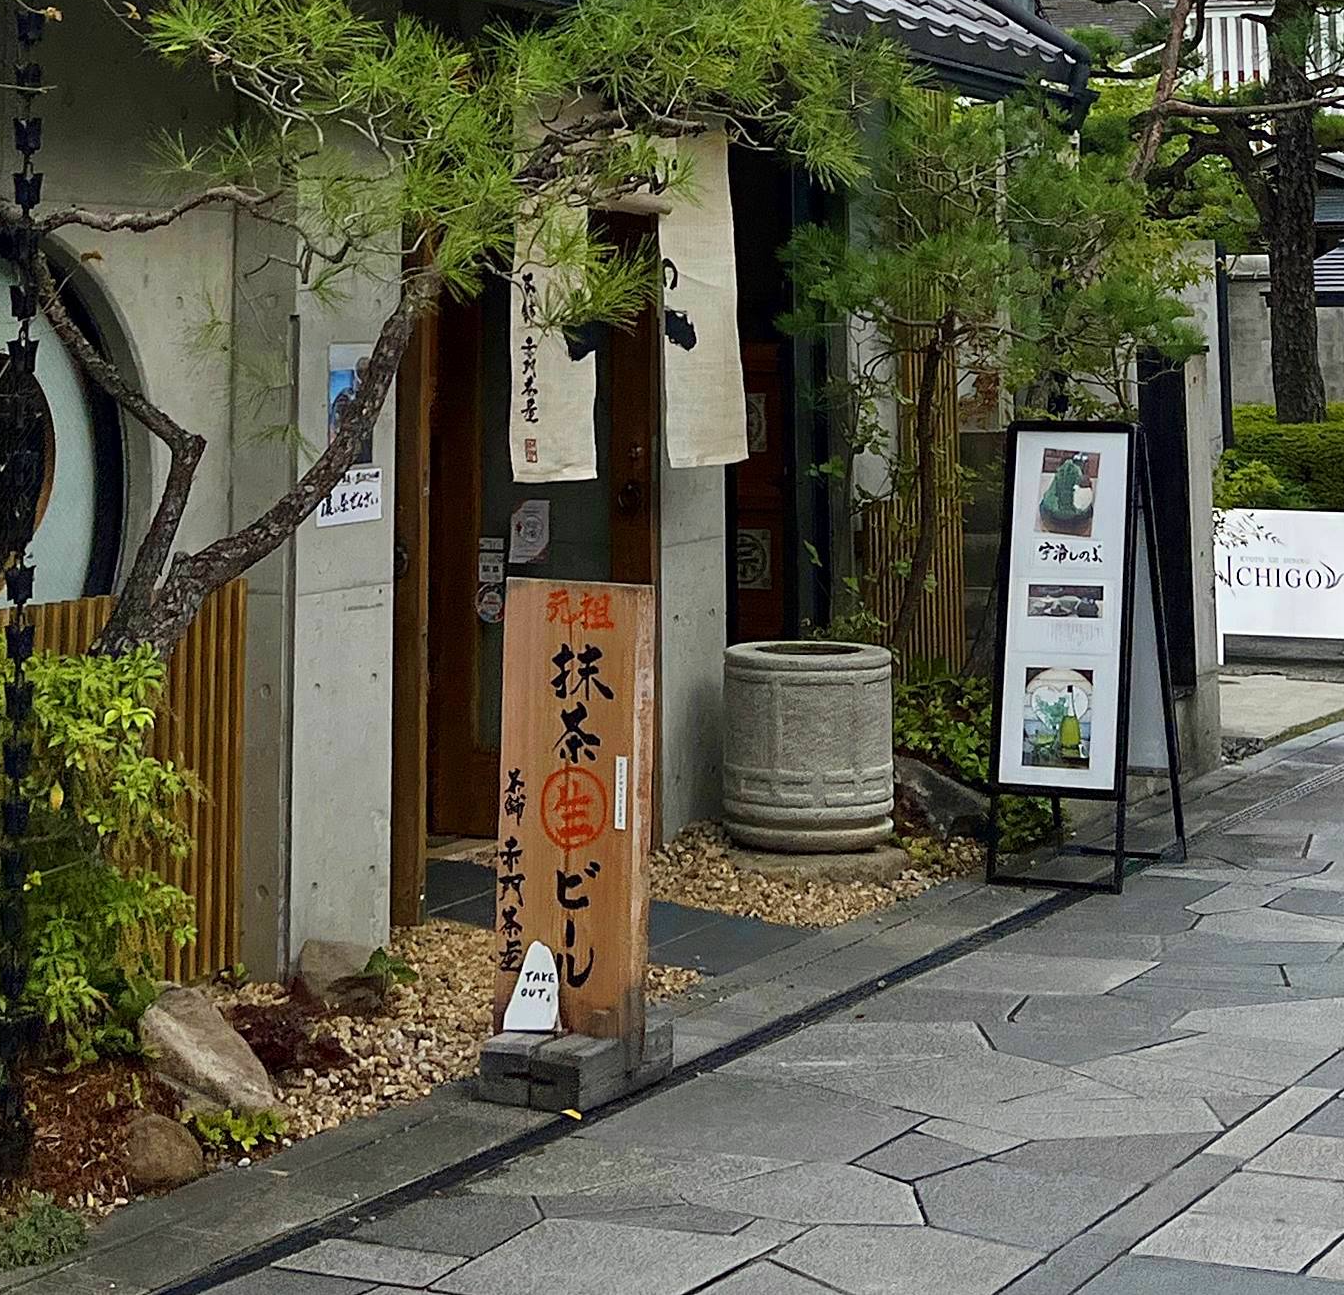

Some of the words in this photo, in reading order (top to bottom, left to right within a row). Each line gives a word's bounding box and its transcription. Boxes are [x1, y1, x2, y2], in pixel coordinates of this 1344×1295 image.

[1038, 541, 1103, 564] 宇治しのぶ
[1227, 556, 1322, 589] ICHIGO
[545, 588, 615, 630] 元祖
[525, 970, 555, 983] TAKE
